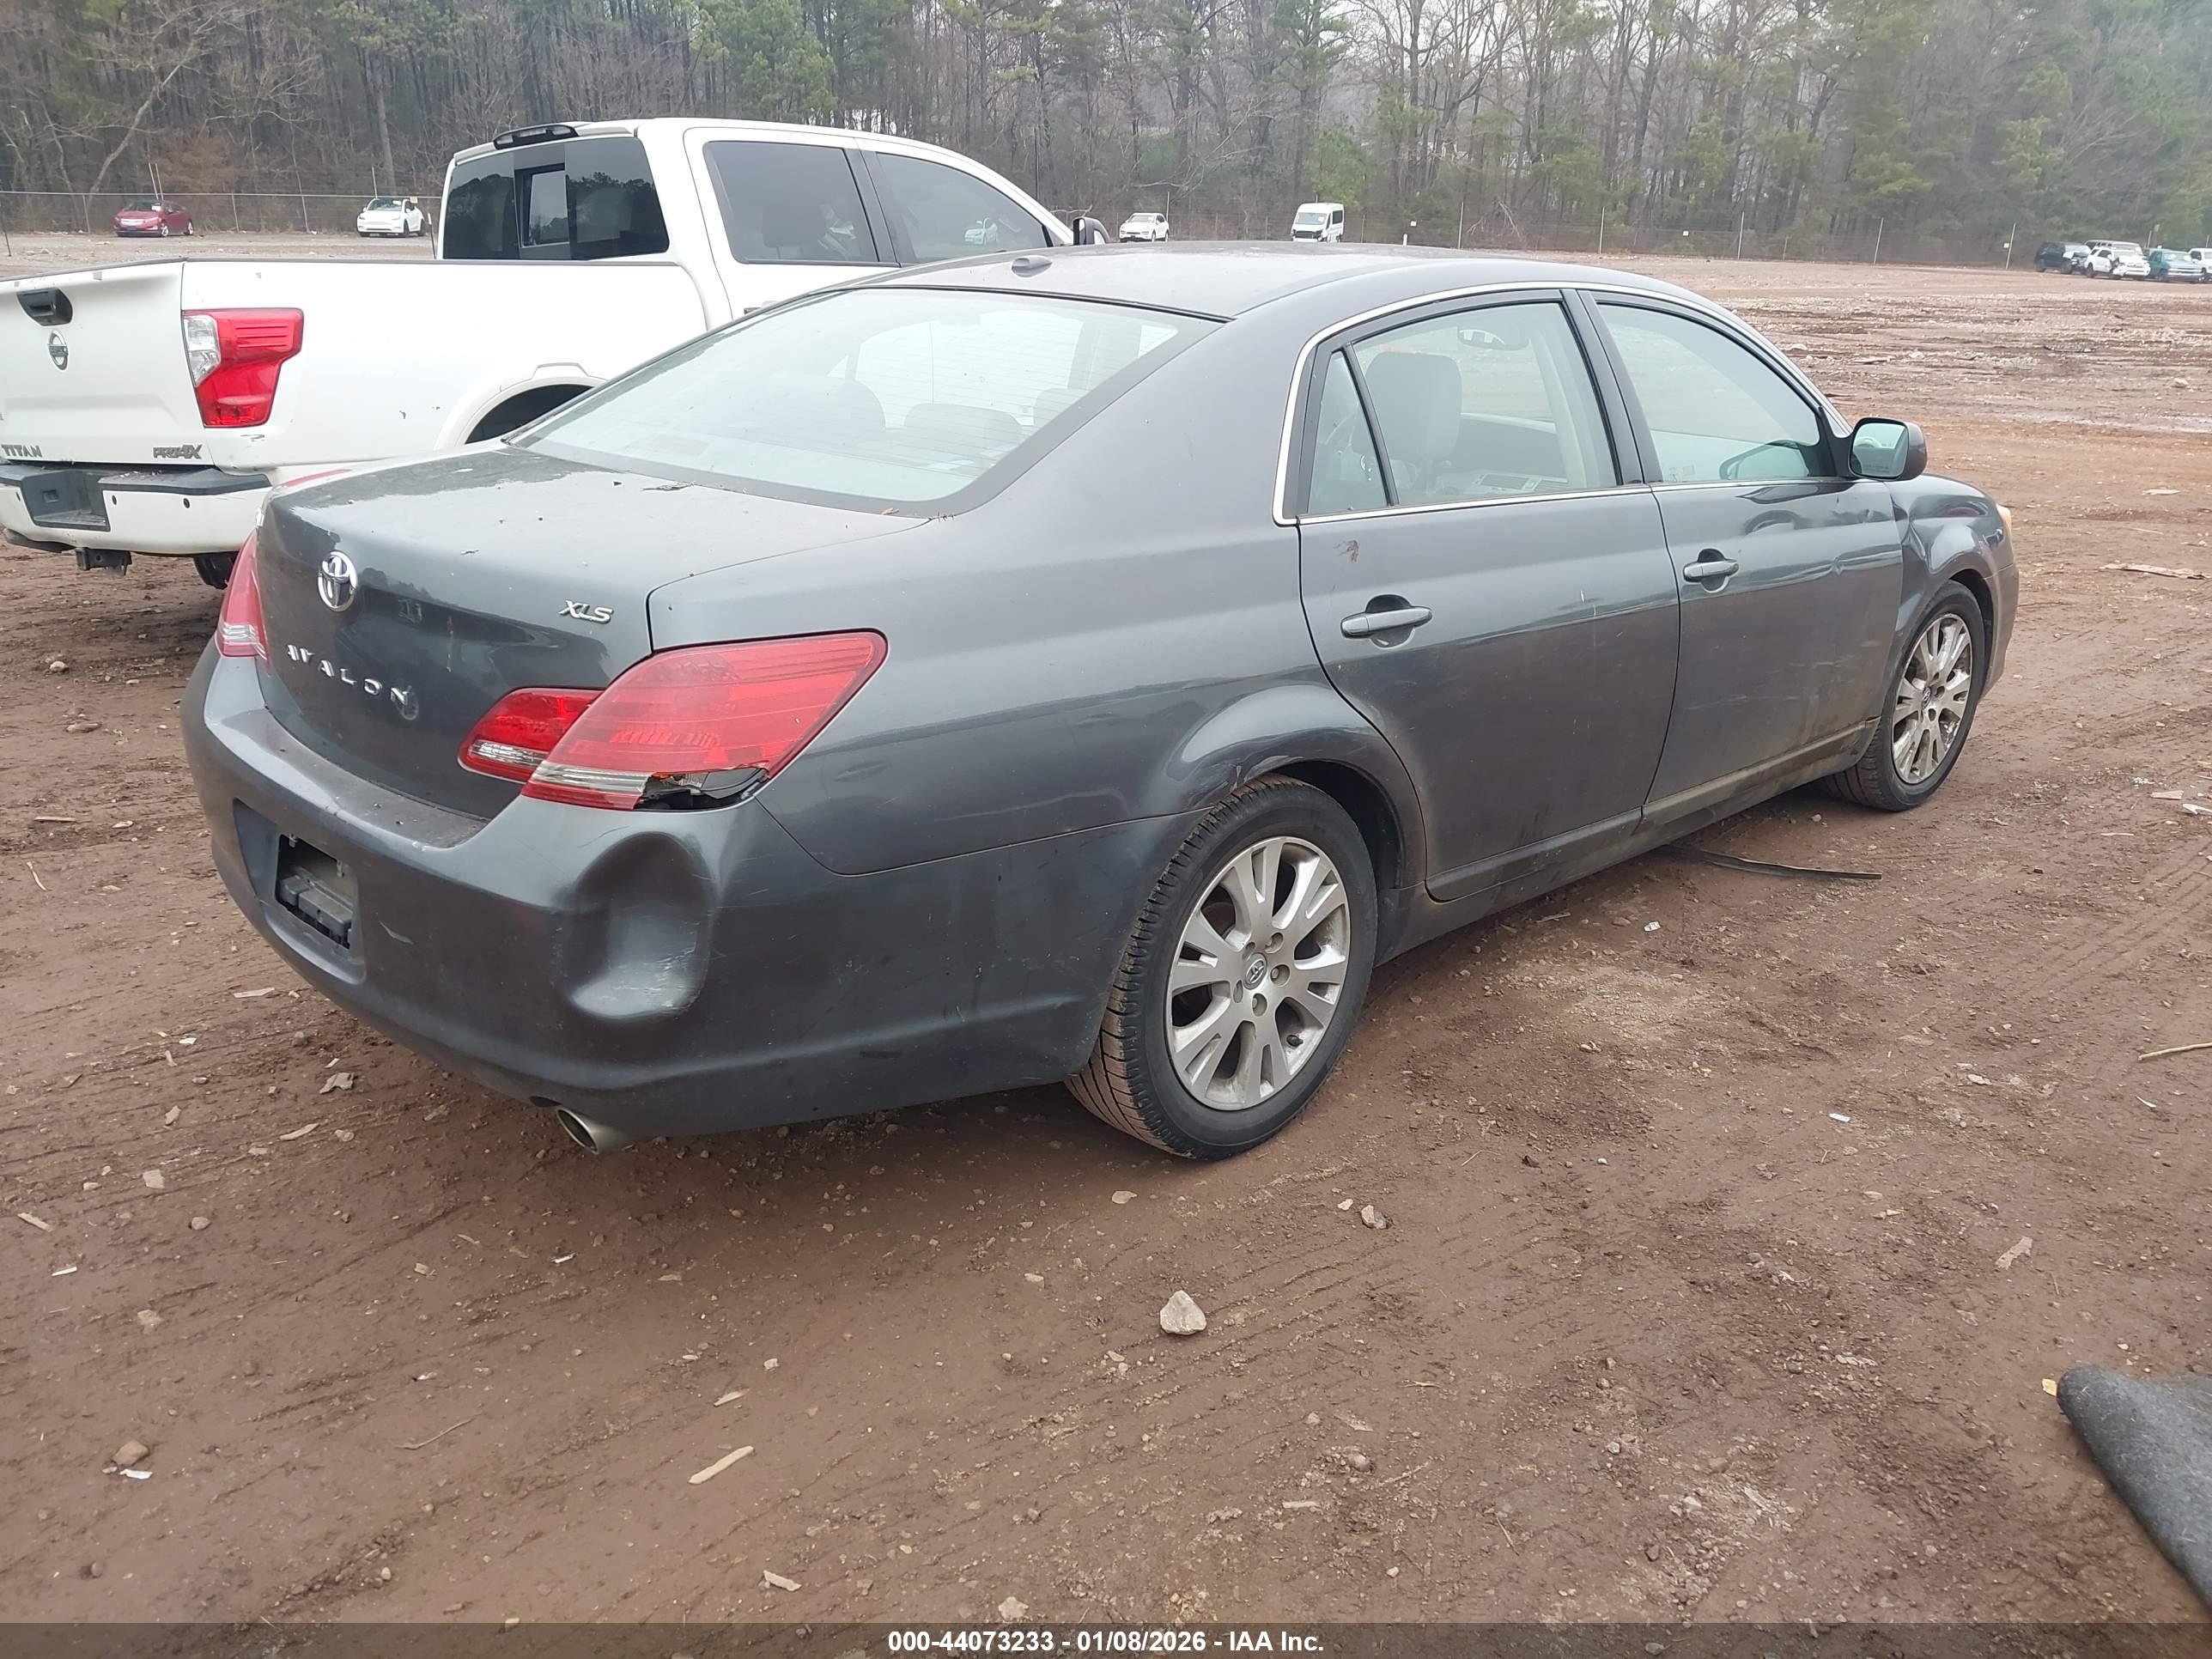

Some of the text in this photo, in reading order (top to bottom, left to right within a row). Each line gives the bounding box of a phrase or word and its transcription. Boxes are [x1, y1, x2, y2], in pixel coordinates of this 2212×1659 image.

[1, 444, 43, 458] TITAN
[558, 599, 614, 624] XLS
[287, 644, 410, 706] AVALON
